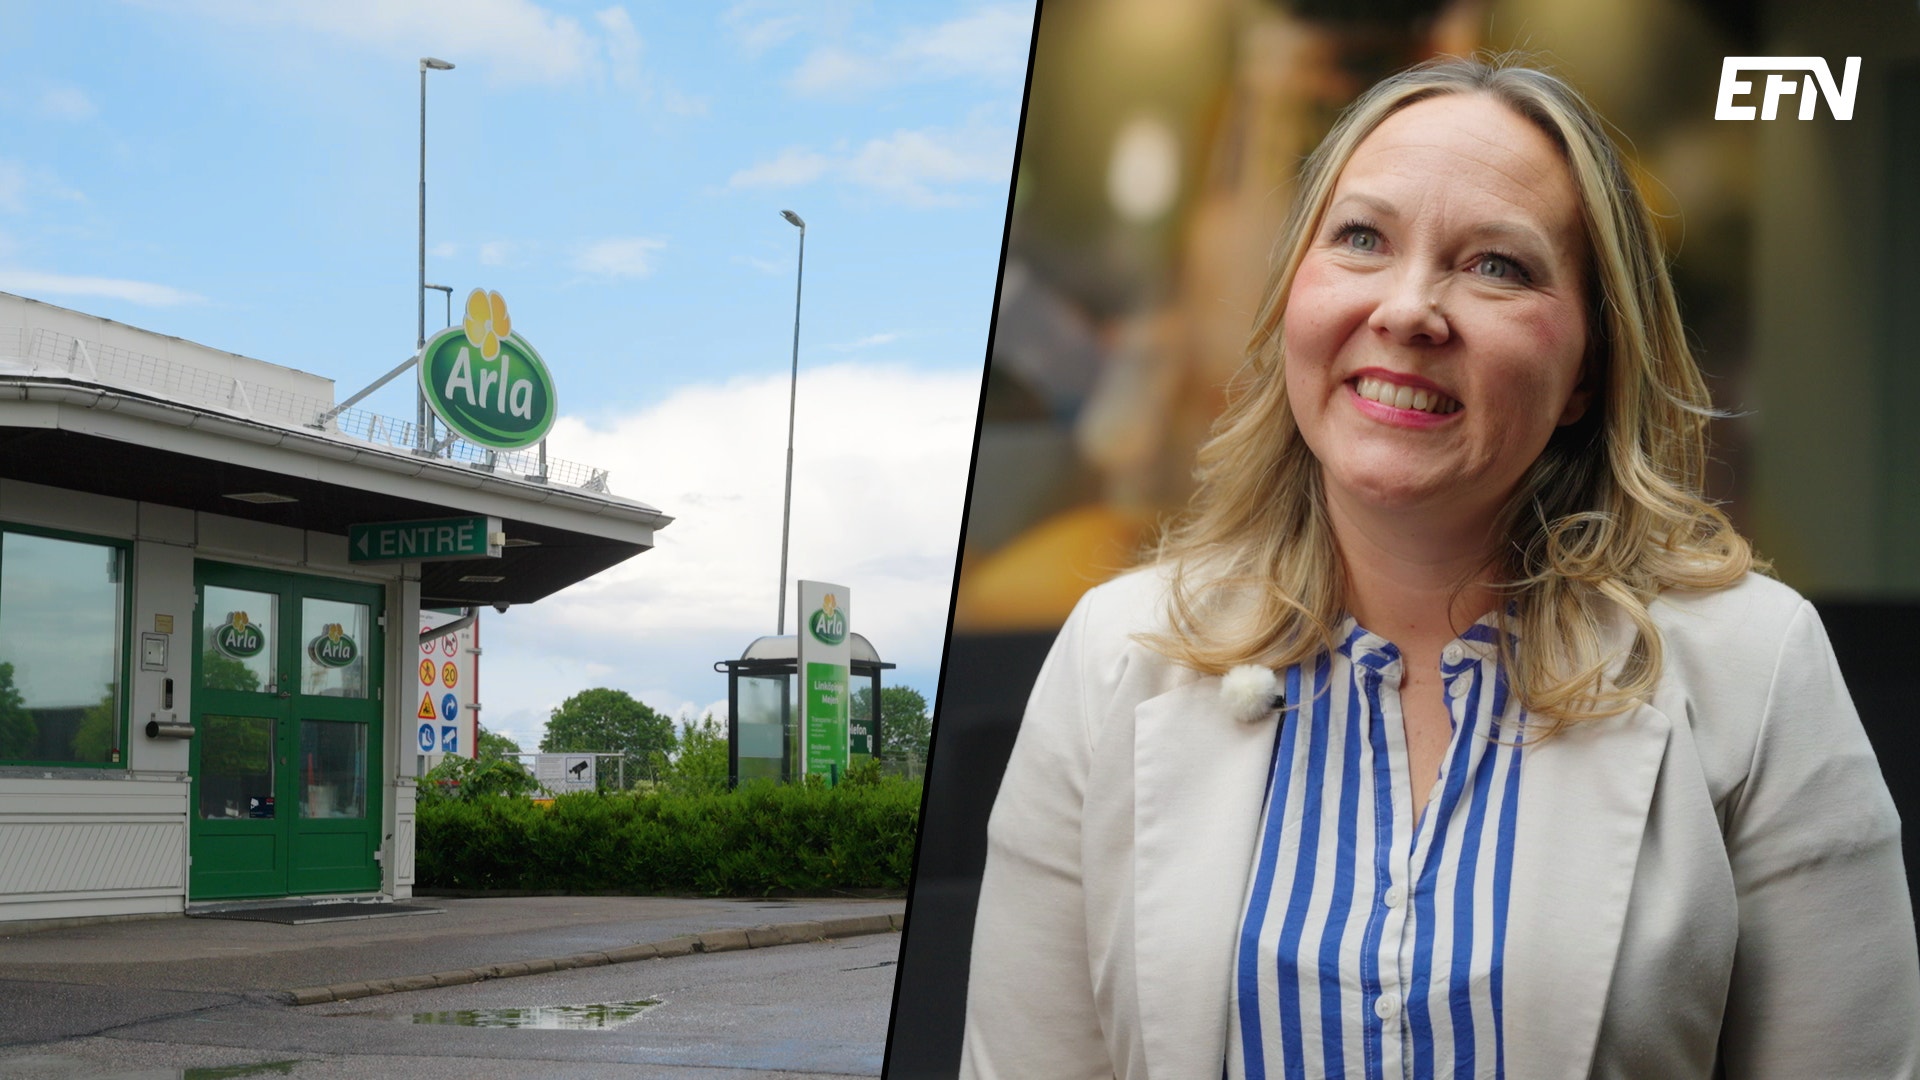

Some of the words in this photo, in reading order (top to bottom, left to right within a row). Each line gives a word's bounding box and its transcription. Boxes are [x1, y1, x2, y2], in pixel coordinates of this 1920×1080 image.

[444, 346, 534, 421] Arla
[379, 519, 474, 556] ENTRÉ
[815, 612, 843, 636] Arla
[225, 629, 258, 649] Arla
[321, 640, 351, 659] Arla
[444, 668, 456, 682] 20
[850, 723, 867, 736] lefon
